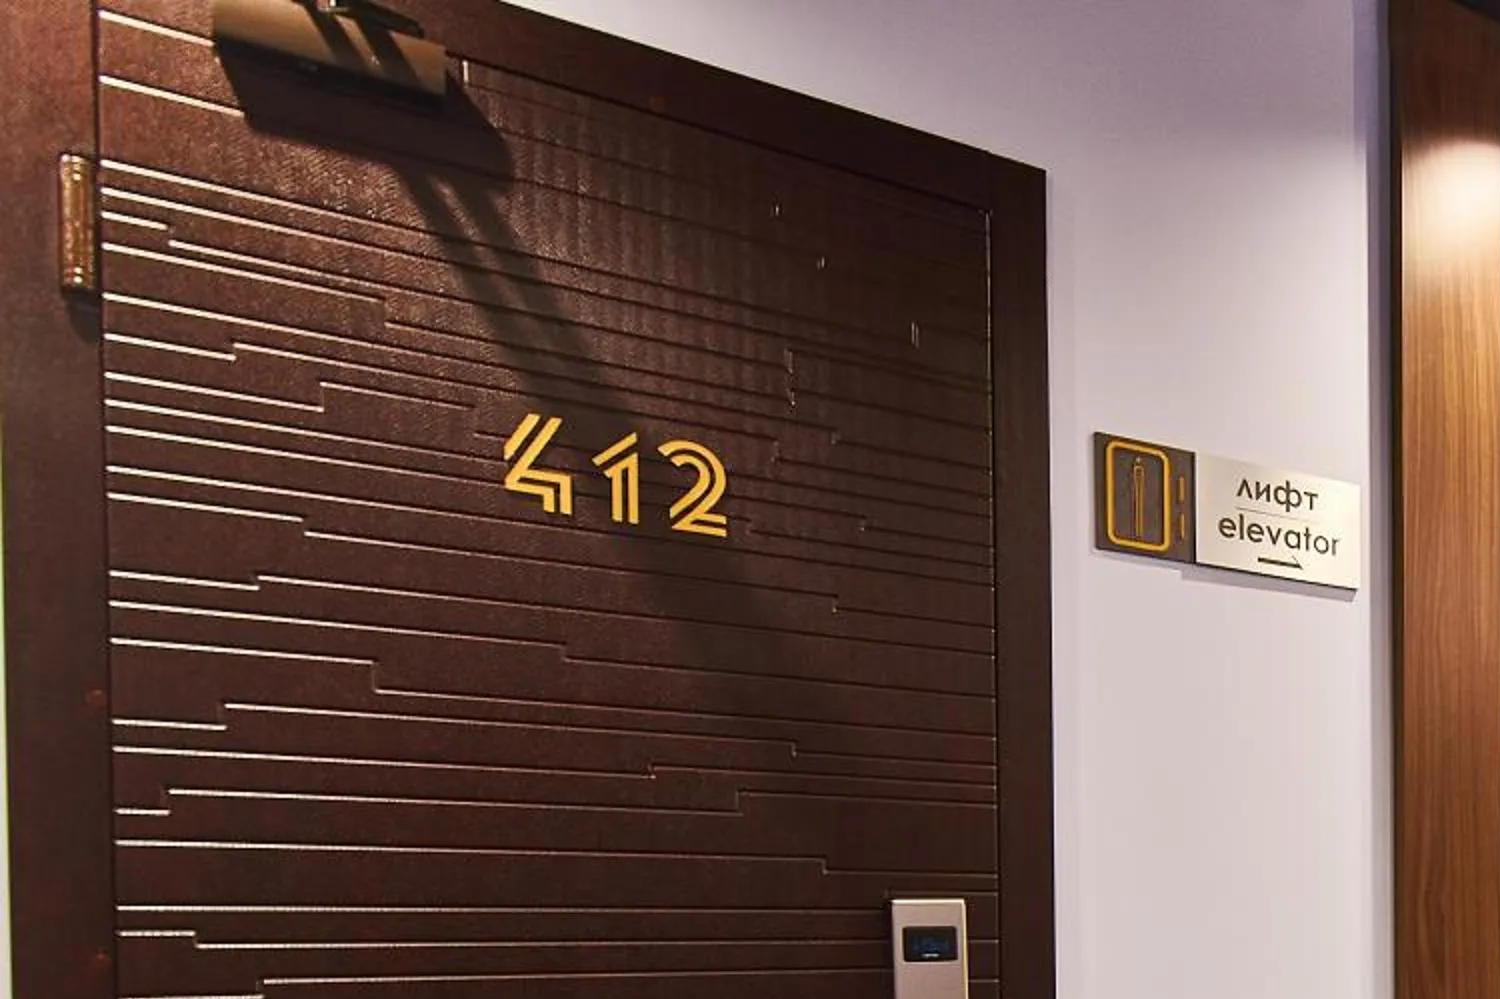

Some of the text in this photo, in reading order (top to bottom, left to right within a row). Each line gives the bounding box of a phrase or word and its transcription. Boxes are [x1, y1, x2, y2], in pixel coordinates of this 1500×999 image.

[504, 413, 727, 537] 412
[1236, 478, 1319, 512] лифт
[1218, 513, 1341, 557] elevator
